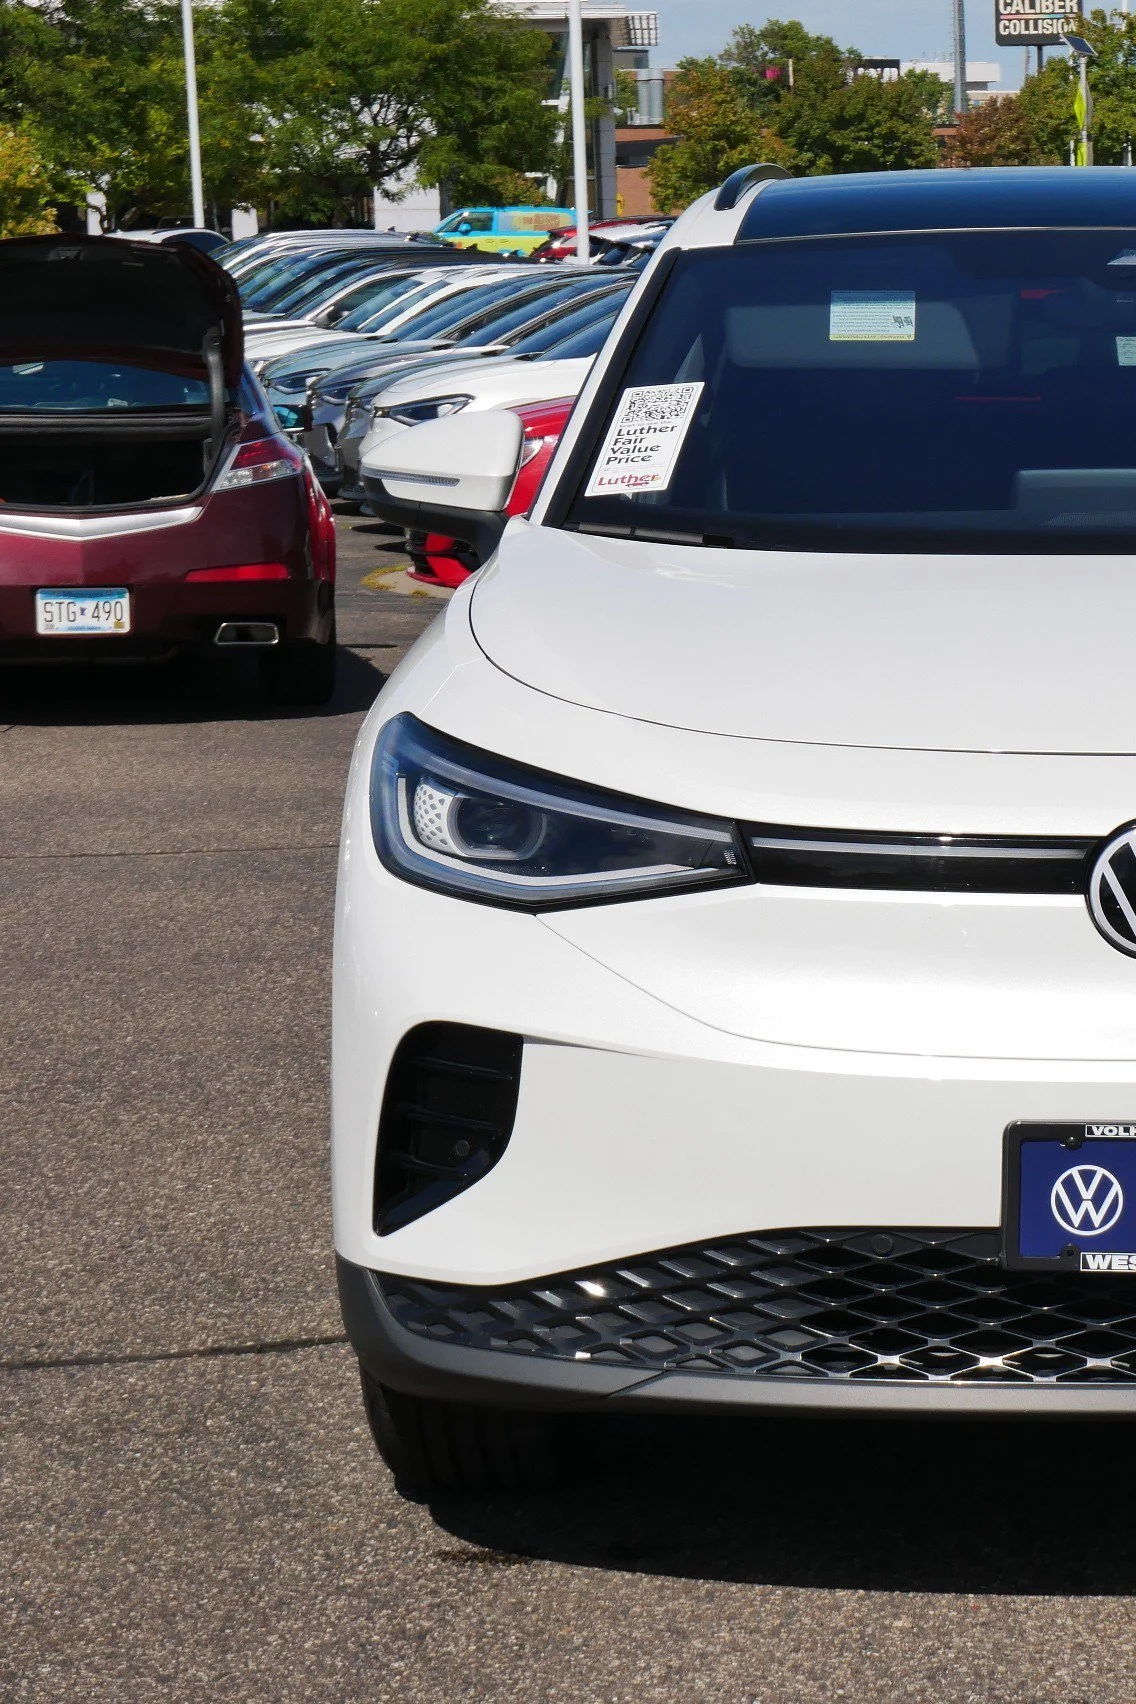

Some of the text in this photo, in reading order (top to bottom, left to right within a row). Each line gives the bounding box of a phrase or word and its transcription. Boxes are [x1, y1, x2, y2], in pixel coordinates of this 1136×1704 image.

[999, 0, 1078, 14] CALIBER
[616, 424, 678, 436] Luther
[612, 435, 647, 447] Fair
[610, 444, 662, 456] Value
[605, 454, 653, 466] Price
[597, 473, 661, 486] Luther
[43, 601, 124, 622] STG 490
